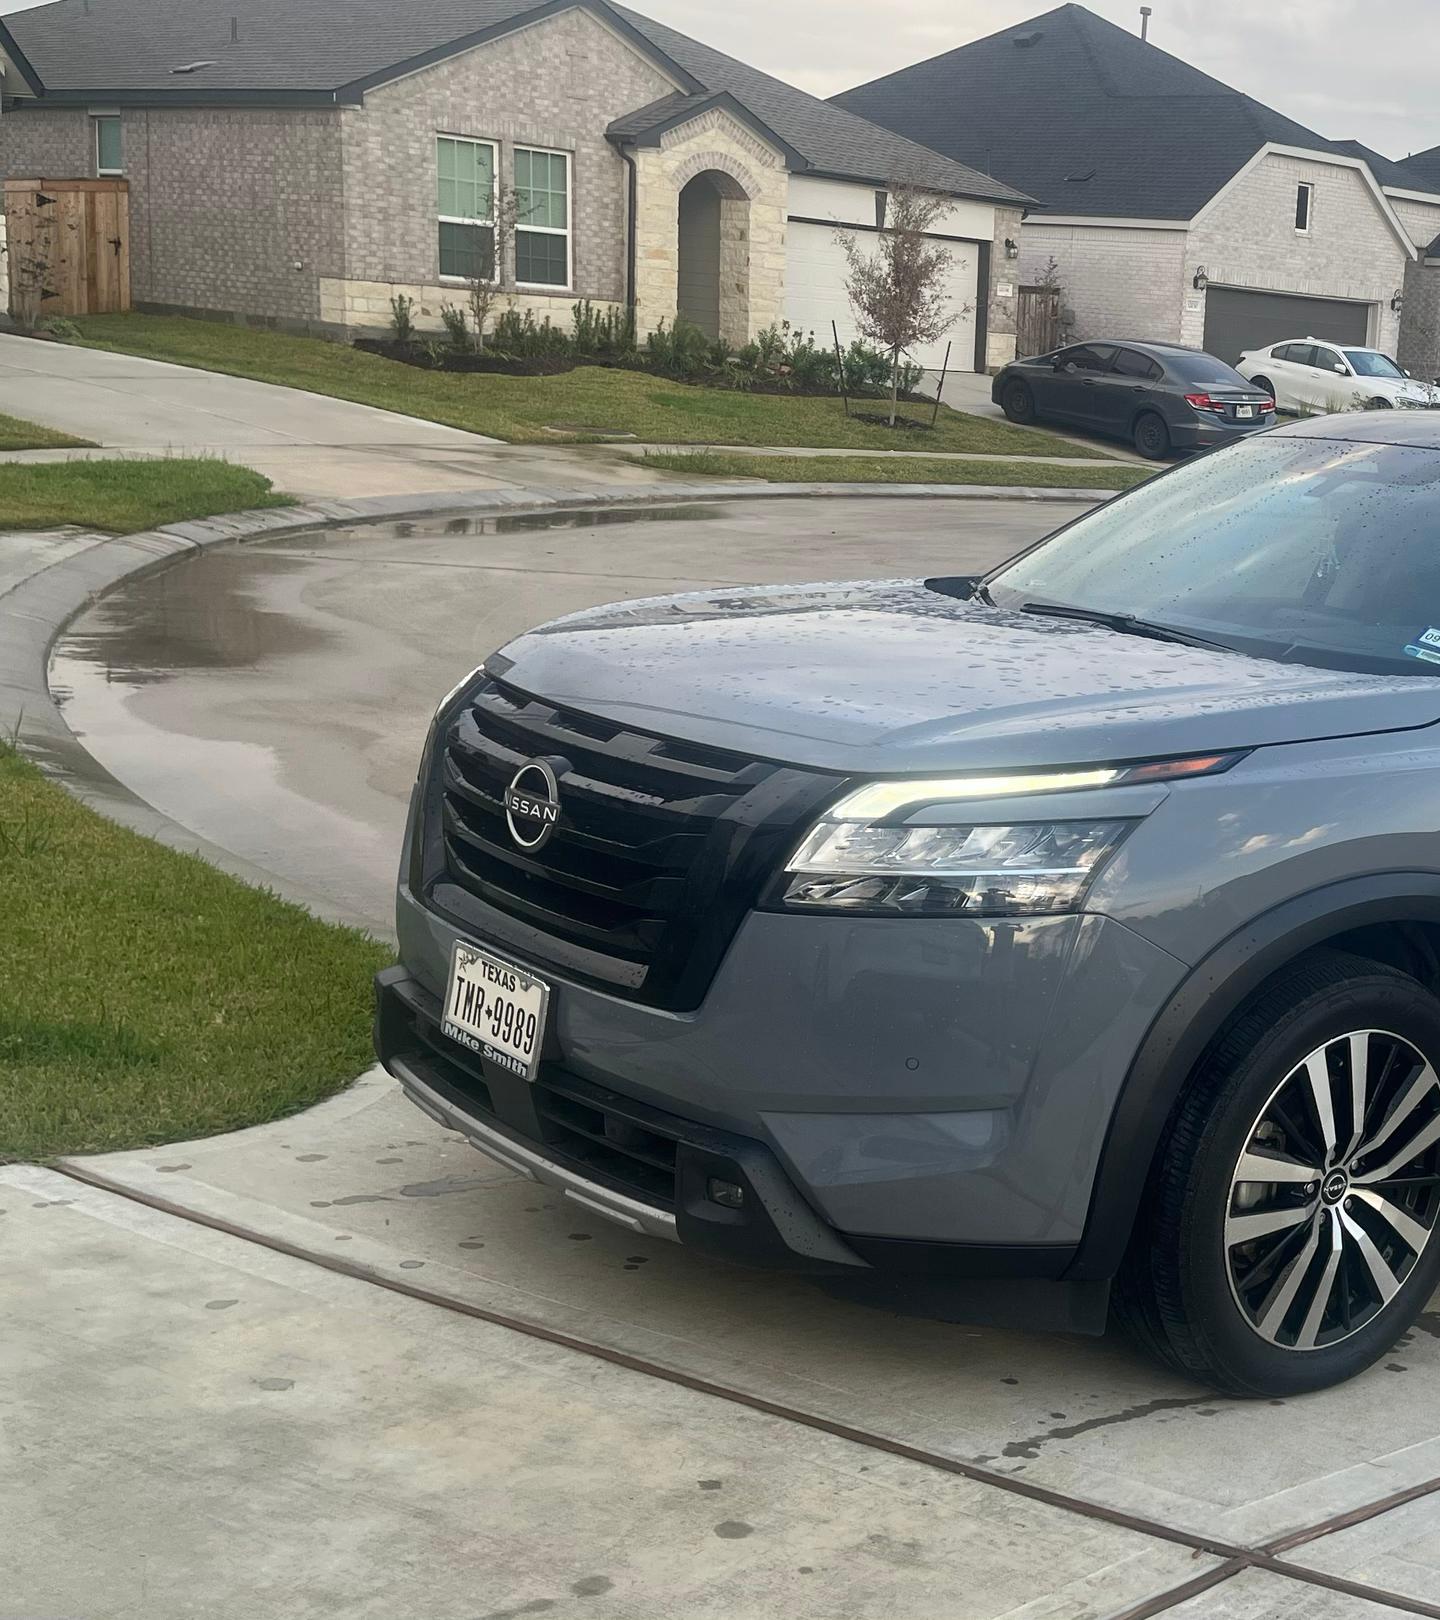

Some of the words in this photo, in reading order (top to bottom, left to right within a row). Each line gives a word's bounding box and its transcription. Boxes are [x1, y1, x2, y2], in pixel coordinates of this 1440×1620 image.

[481, 960, 516, 993] TEXAS
[444, 1022, 480, 1051] Mike
[482, 1044, 528, 1078] Smith
